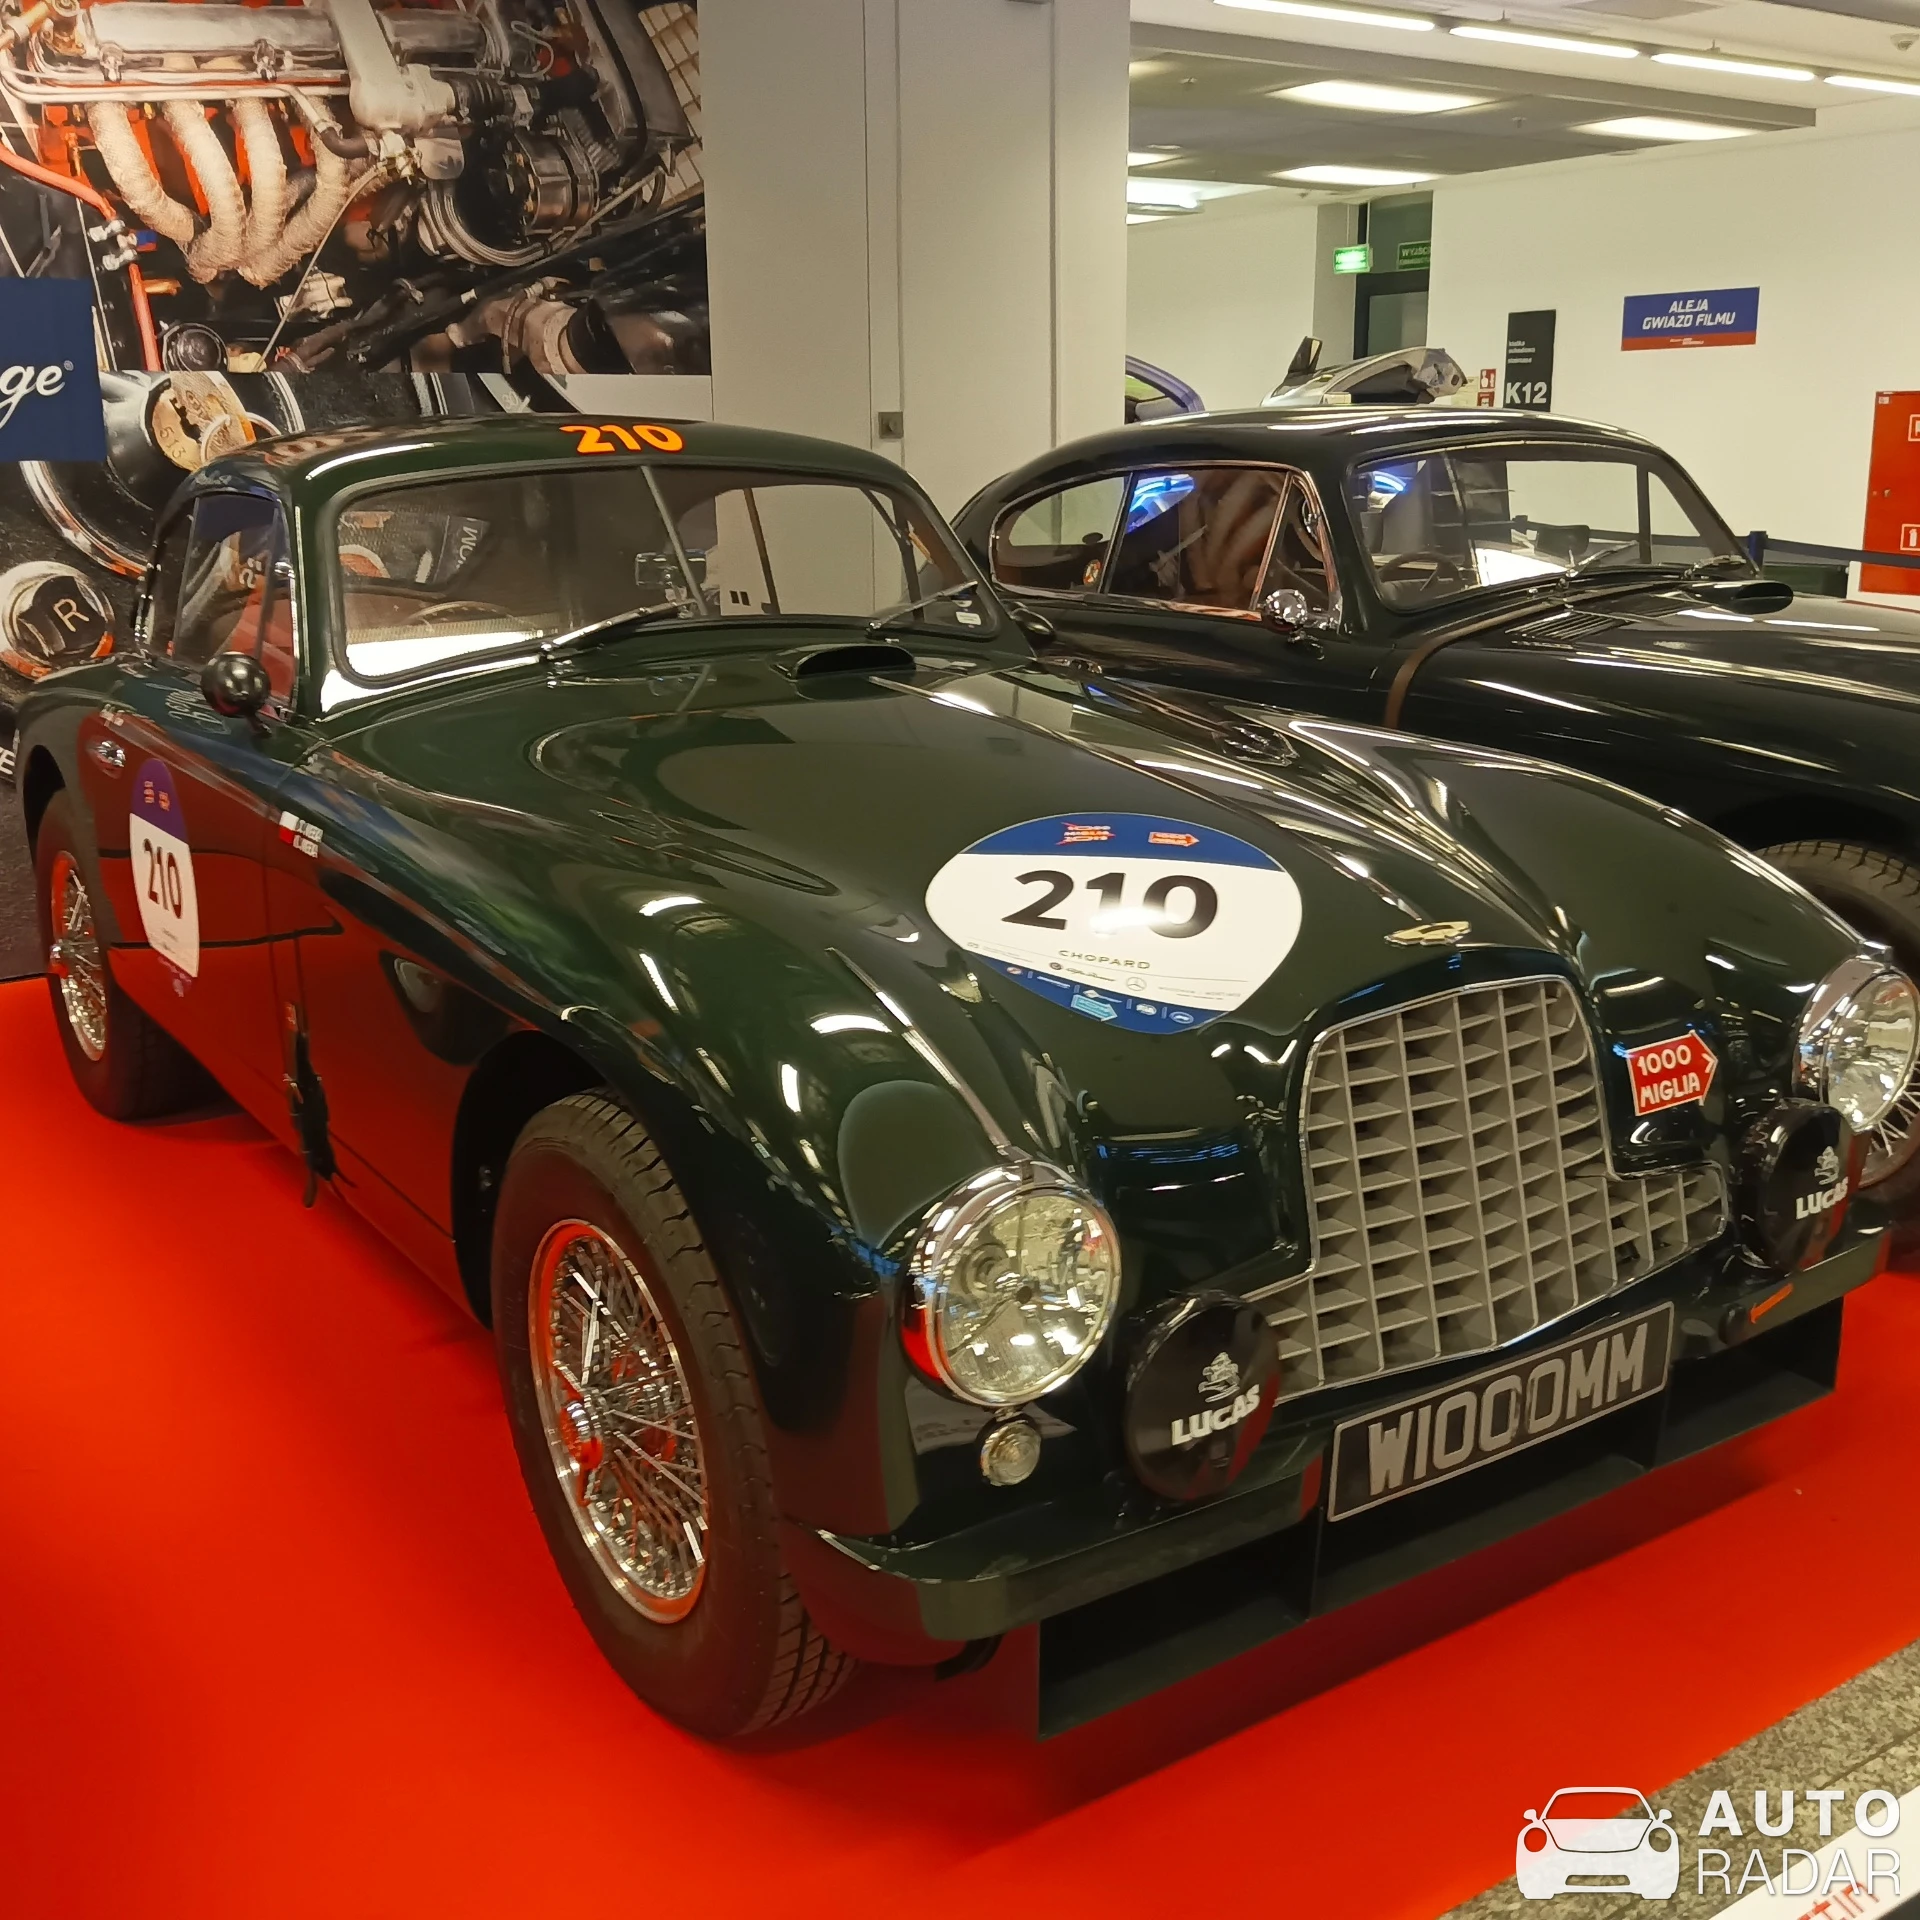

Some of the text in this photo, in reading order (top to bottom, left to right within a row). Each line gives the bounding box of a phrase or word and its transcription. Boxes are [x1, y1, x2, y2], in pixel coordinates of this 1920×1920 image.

[1668, 298, 1708, 314] ALEJA
[1695, 311, 1736, 327] FILMU
[1505, 381, 1547, 405] K12
[558, 423, 684, 454] 210
[53, 597, 90, 633] R
[142, 837, 183, 920] 210
[1001, 869, 1218, 939] 210
[1058, 949, 1152, 970] CHOPARD
[1636, 1043, 1692, 1077] 1000
[1640, 1072, 1701, 1108] MIGLIA
[1795, 1176, 1849, 1221] LUCAS
[1171, 1383, 1261, 1446] LUCAS
